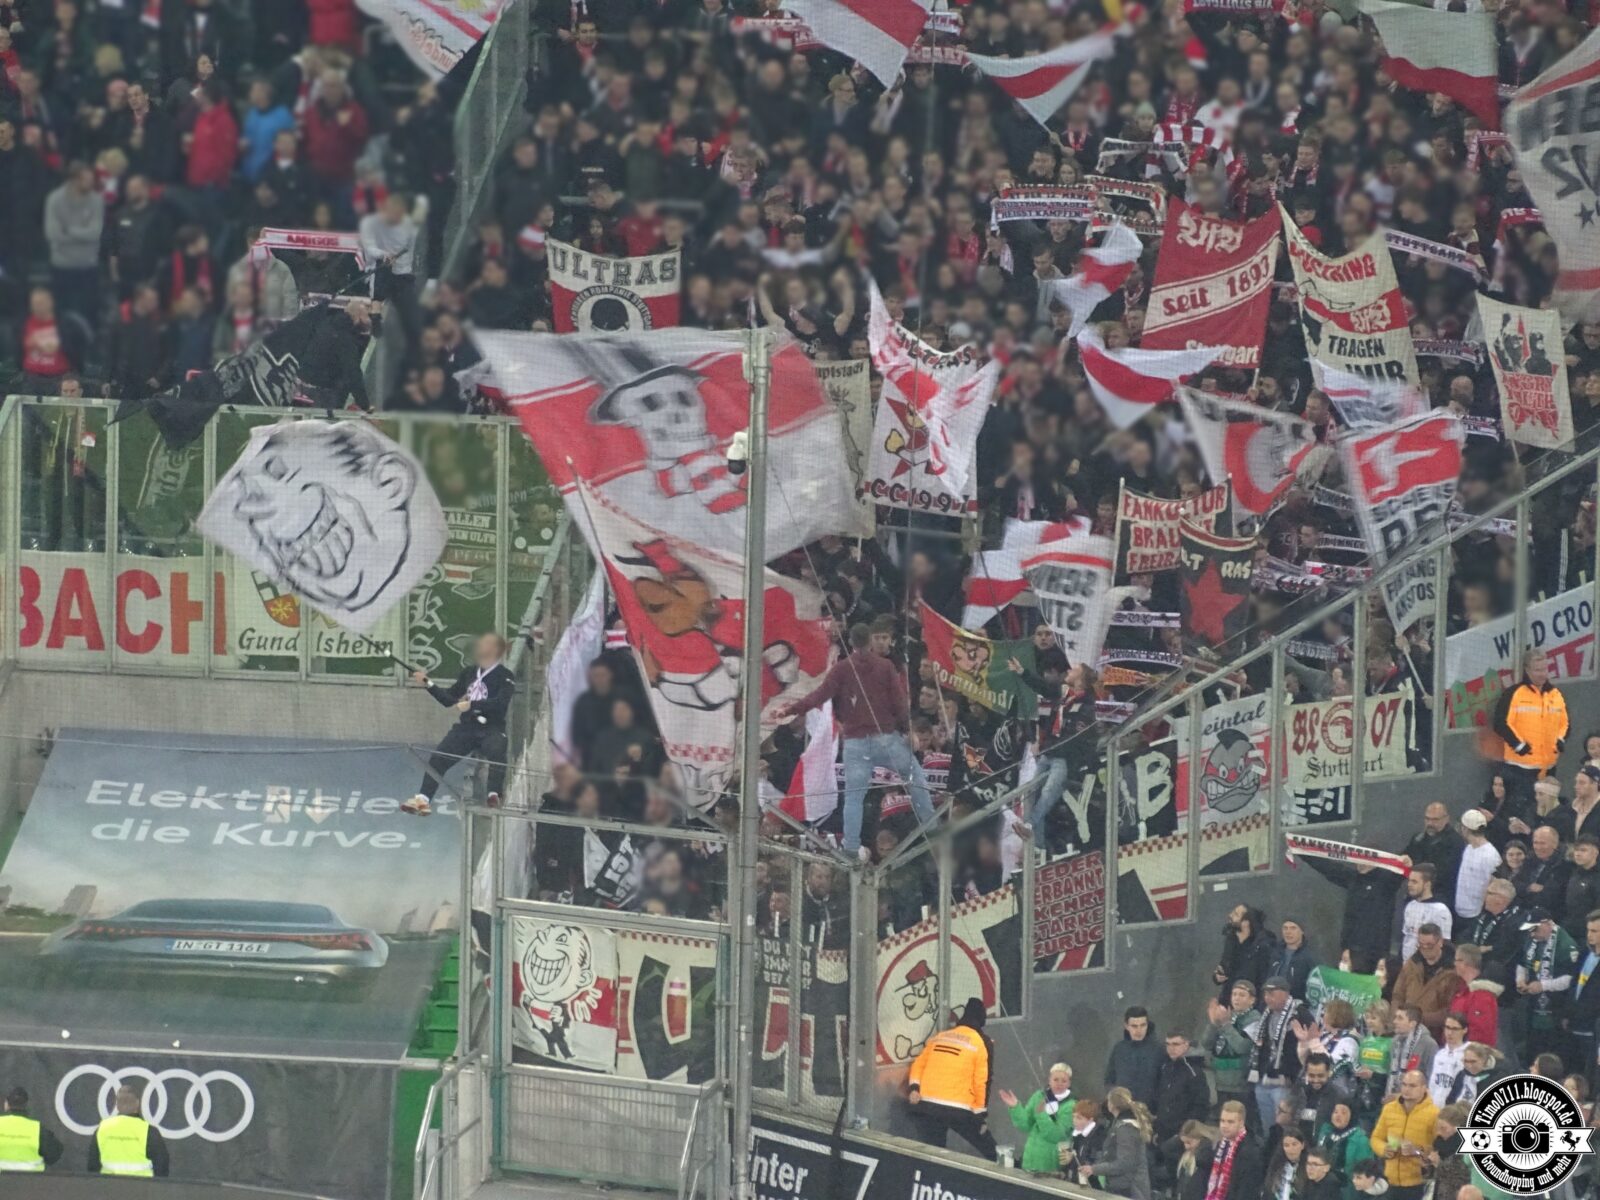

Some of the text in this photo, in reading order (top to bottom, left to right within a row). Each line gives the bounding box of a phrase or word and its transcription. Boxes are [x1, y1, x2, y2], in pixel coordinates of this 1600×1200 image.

[549, 245, 679, 286] ULTRAS
[1162, 287, 1211, 317] seit
[1328, 335, 1386, 358] TRAGEN
[238, 626, 394, 656] Gundlsheim
[1371, 698, 1401, 749] 07
[1303, 752, 1384, 783] Stuttart
[86, 779, 458, 817] Elektrisiet
[91, 817, 423, 849] die Kurve.
[763, 938, 781, 955] DU
[751, 1152, 809, 1194] nter
